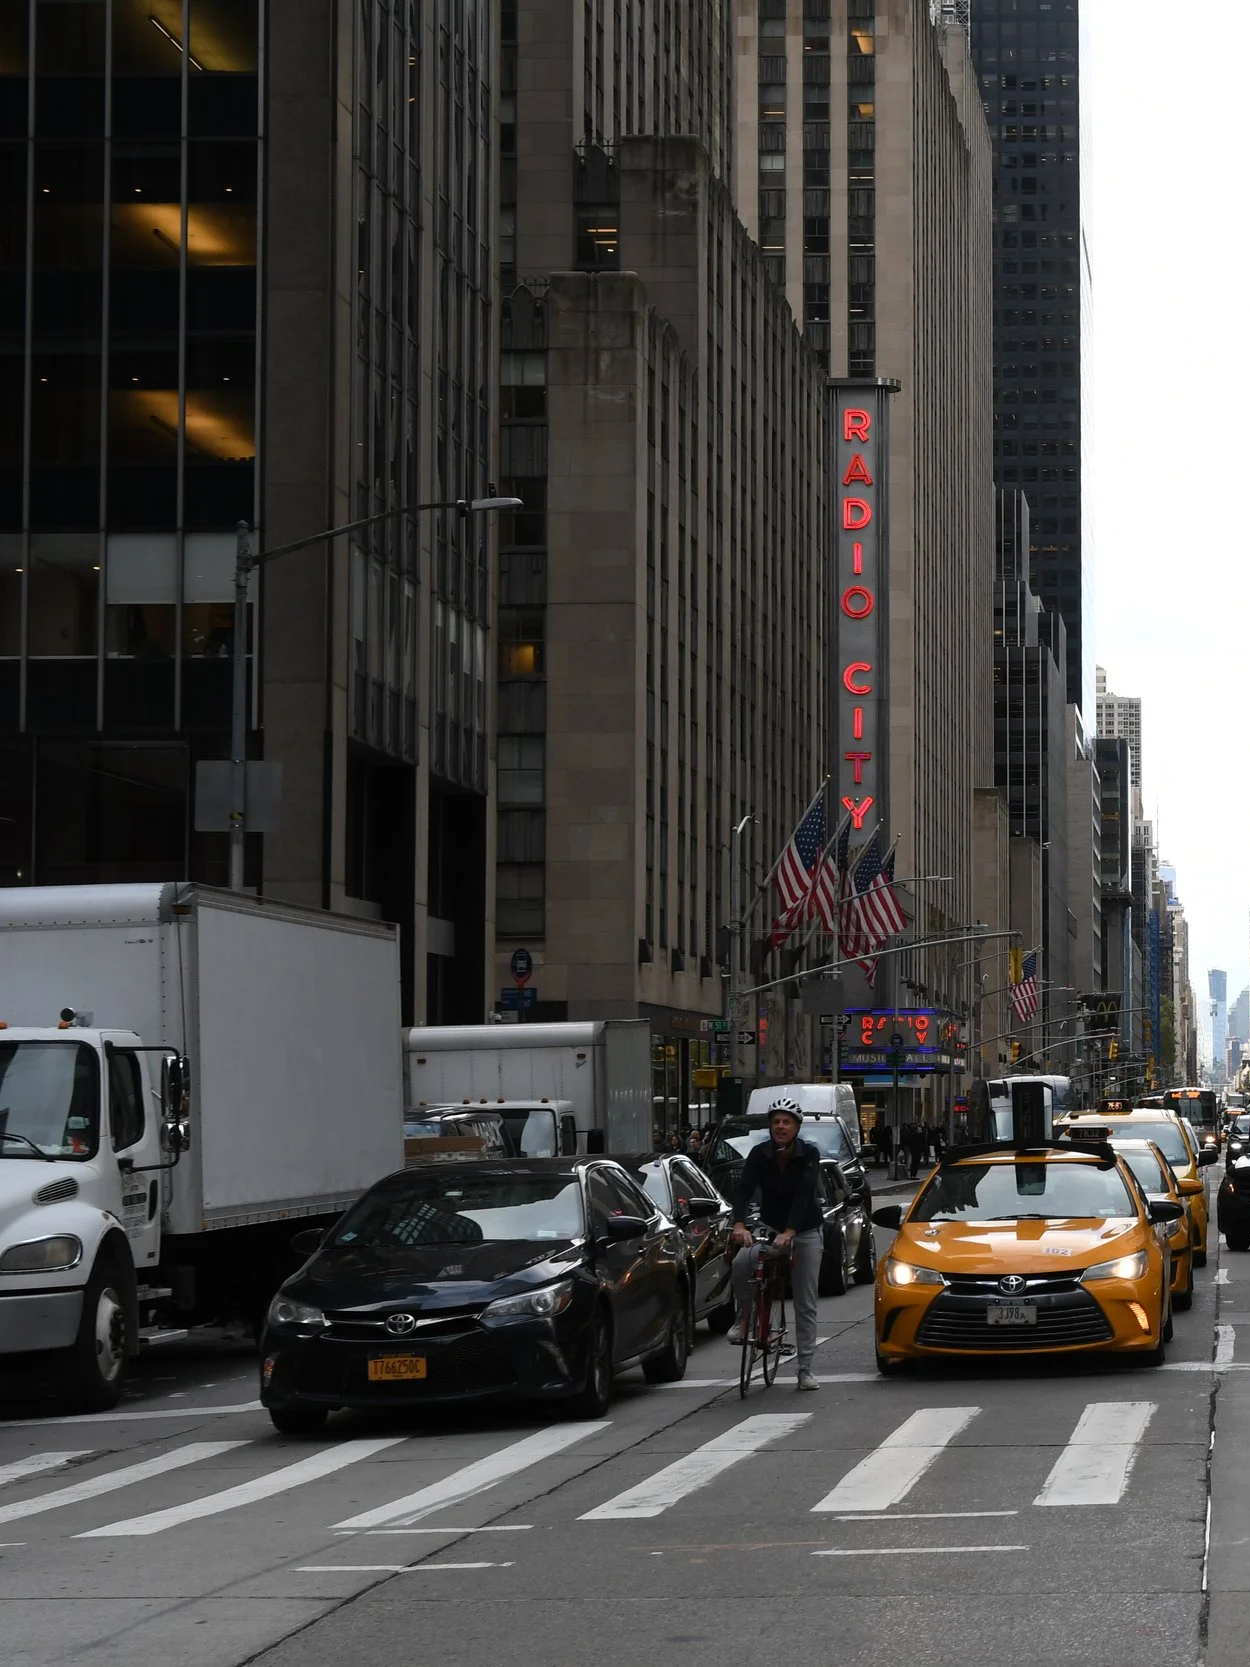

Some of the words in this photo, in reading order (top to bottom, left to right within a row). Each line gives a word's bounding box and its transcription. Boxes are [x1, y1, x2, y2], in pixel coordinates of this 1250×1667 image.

[840, 408, 874, 618] RADIO
[842, 663, 875, 830] CITY
[1046, 1247, 1068, 1256] 102
